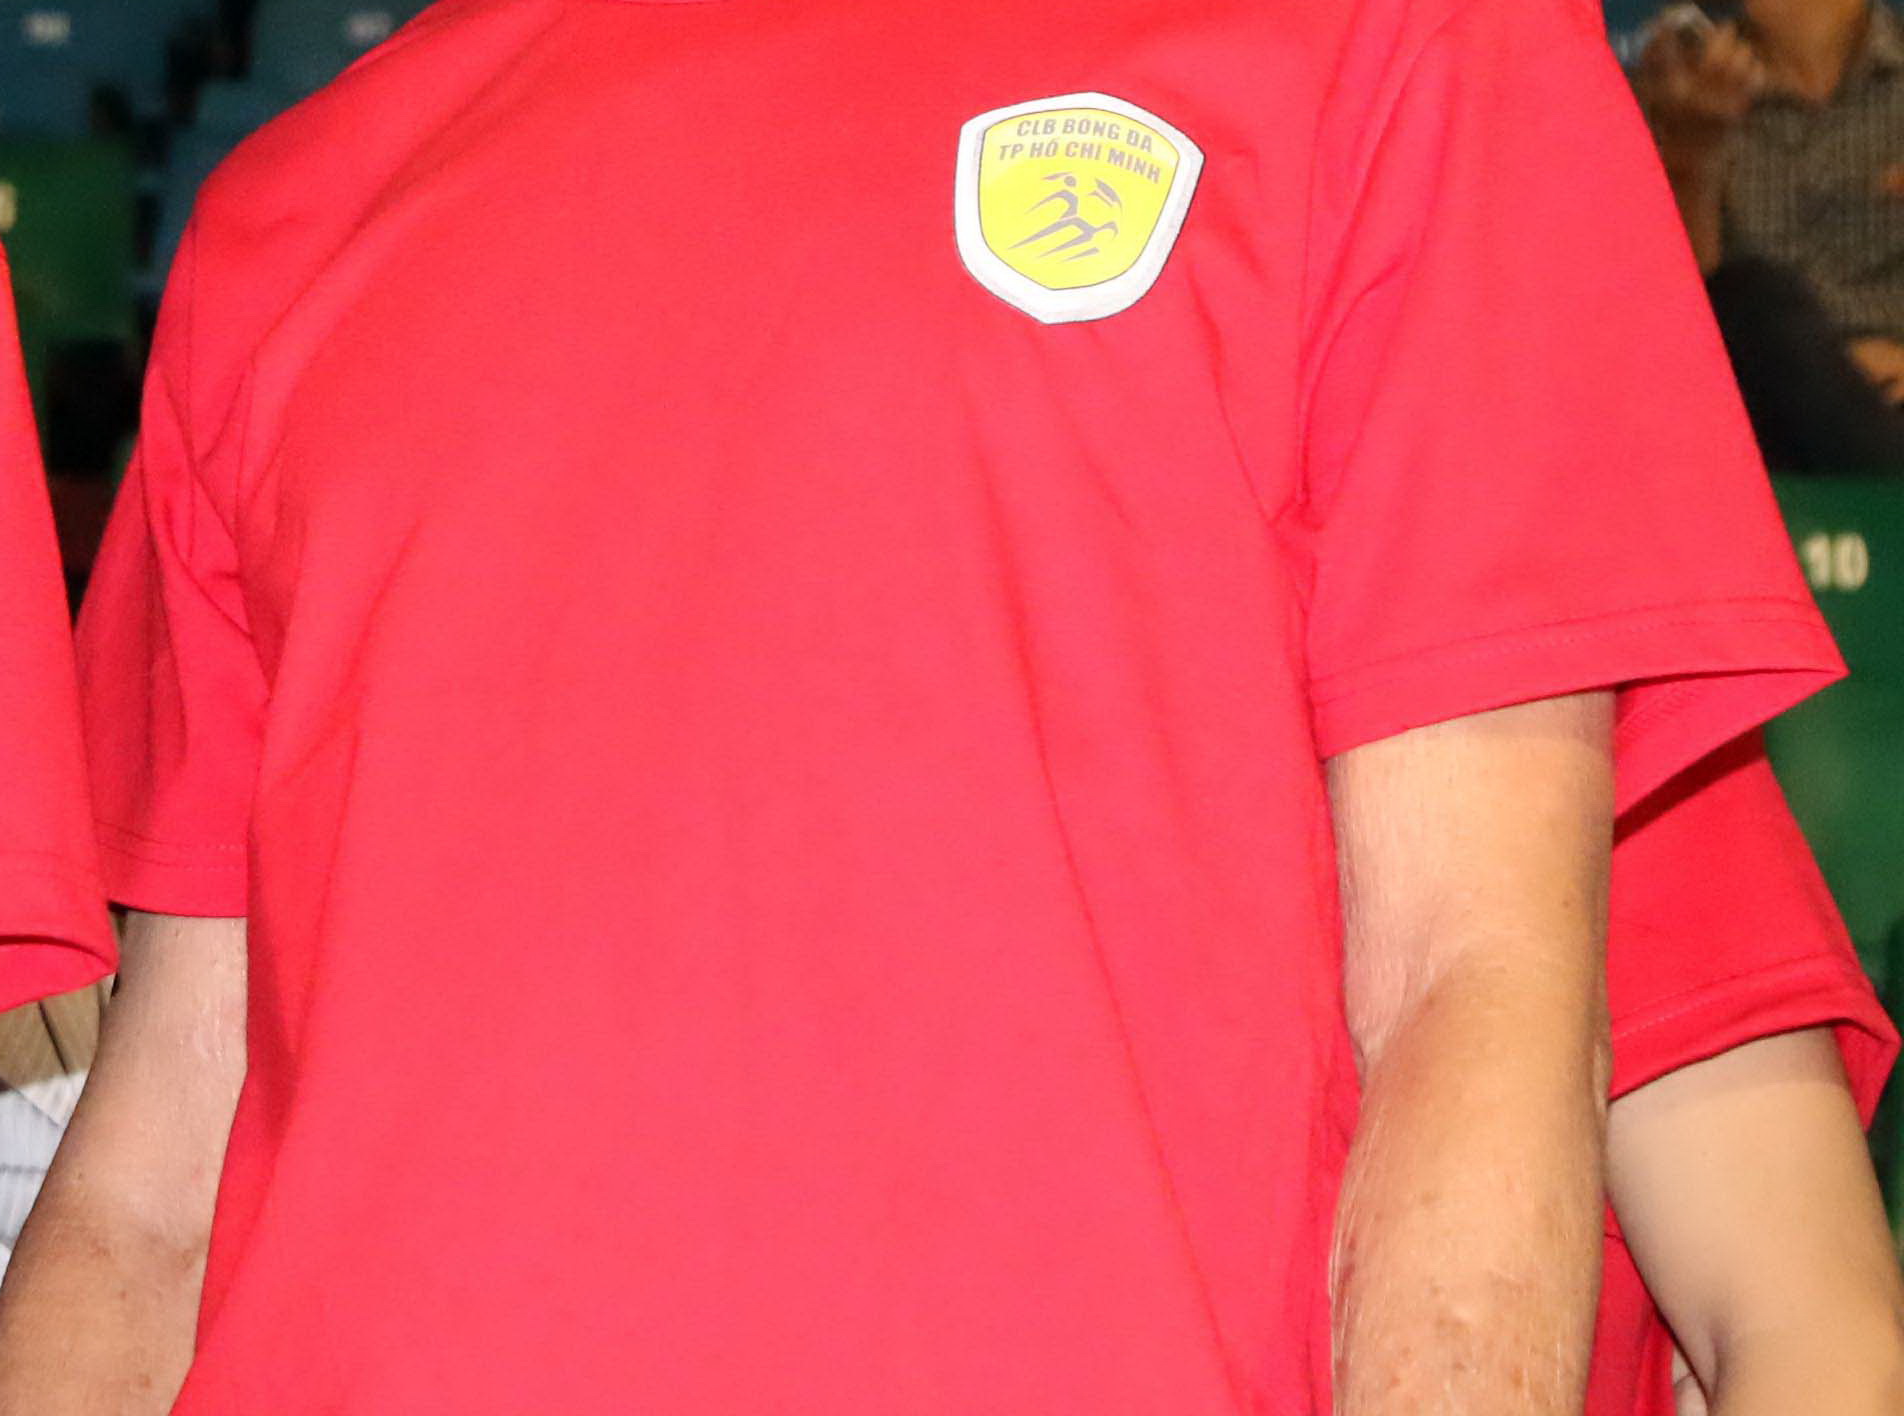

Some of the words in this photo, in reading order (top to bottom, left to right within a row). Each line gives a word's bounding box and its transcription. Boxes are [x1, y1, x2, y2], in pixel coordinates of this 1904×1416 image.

[1016, 119, 1057, 137] CLB
[999, 143, 1024, 161] TP
[1106, 147, 1161, 185] MINH
